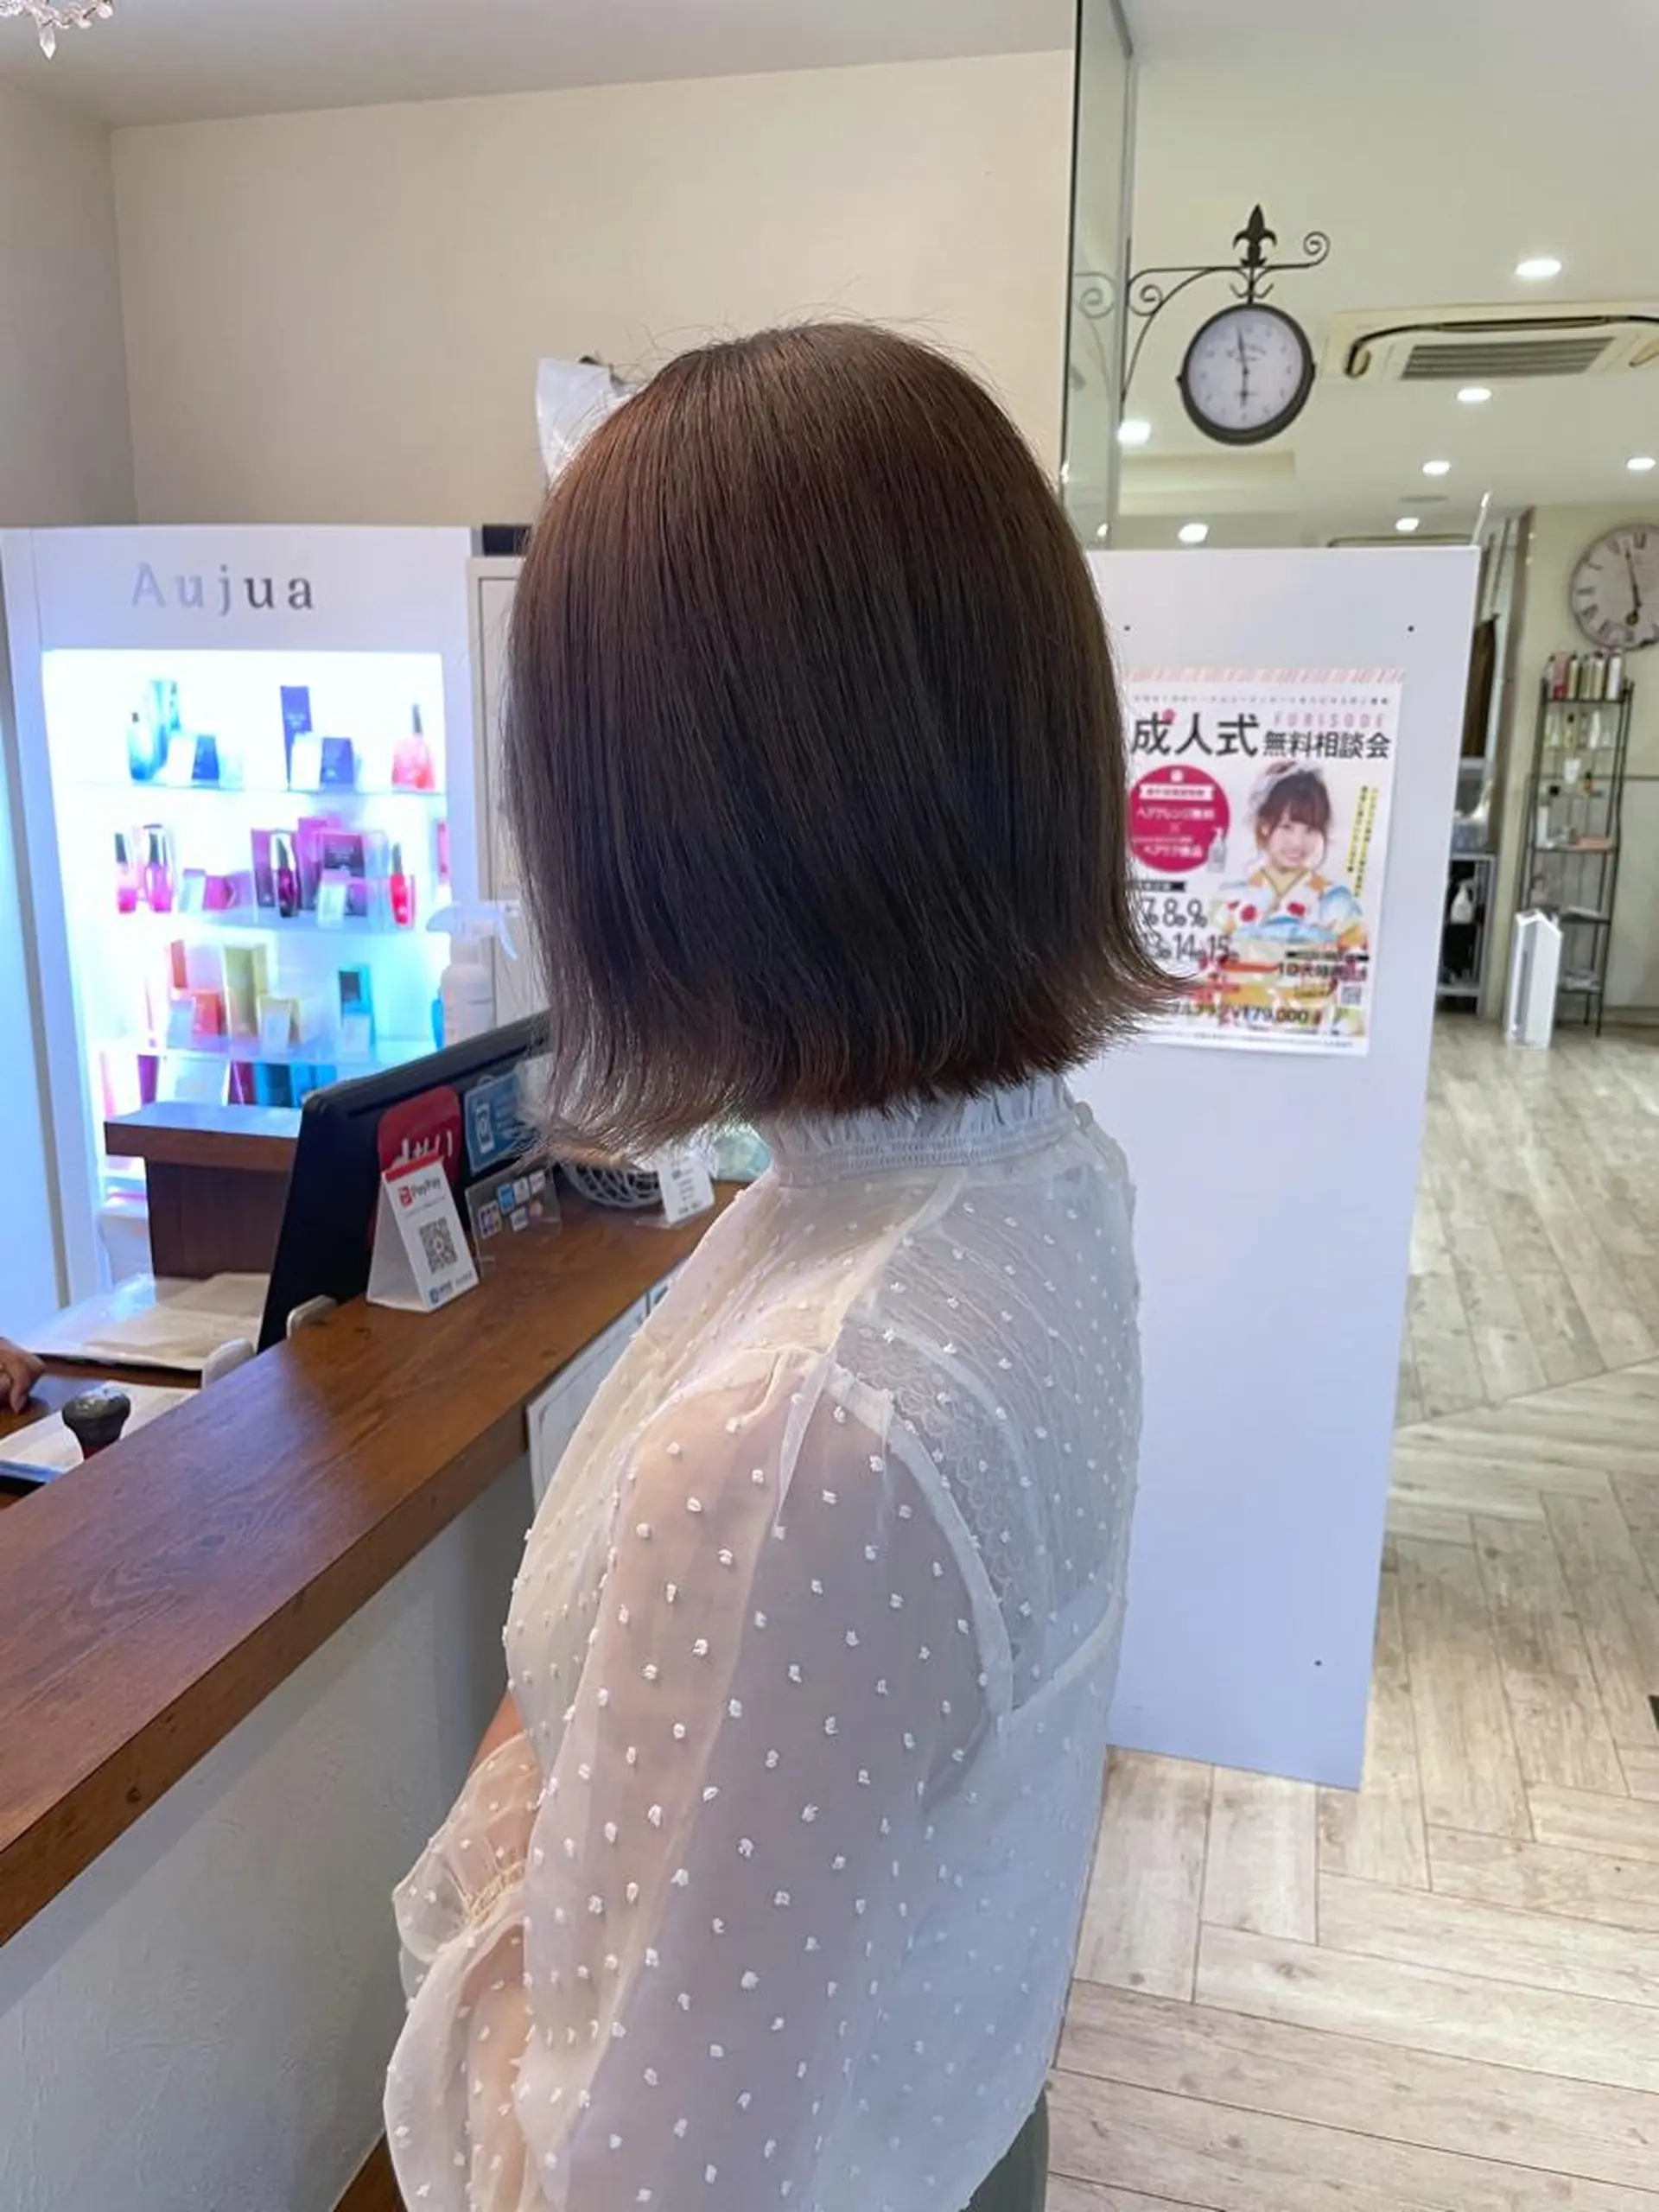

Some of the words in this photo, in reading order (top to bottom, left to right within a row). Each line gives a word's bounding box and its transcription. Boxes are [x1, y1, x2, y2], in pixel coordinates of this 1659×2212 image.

[131, 562, 315, 617] Aujua
[1130, 711, 1260, 757] 成人式
[1262, 731, 1392, 759] 無料相談会
[1274, 713, 1386, 728] FURISODE
